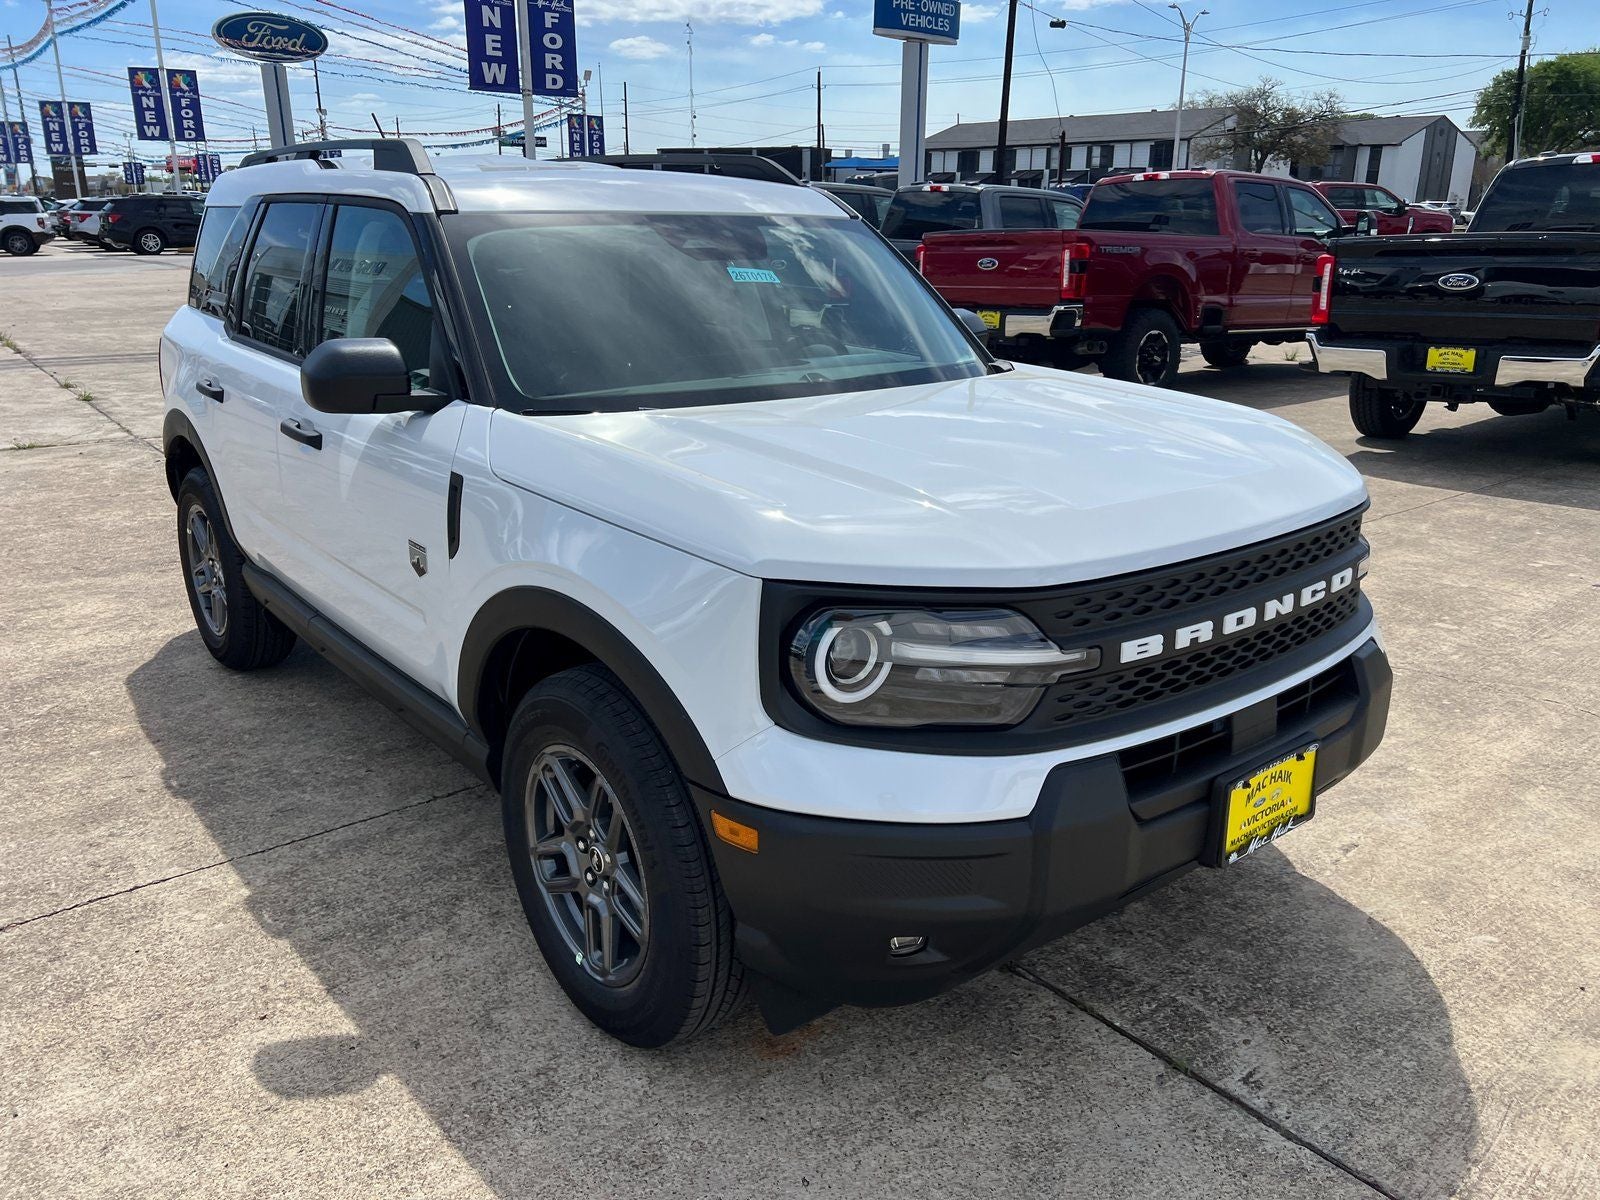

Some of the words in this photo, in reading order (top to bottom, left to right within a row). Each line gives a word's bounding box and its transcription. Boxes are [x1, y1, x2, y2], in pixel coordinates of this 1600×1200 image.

[242, 21, 306, 50] Ford
[901, 13, 950, 32] VEHICLES
[481, 5, 507, 85] NEW
[542, 12, 564, 90] FORD
[141, 96, 160, 137] NEW
[180, 98, 196, 139] FORD
[18, 137, 29, 162] FORD
[49, 122, 63, 152] NEW
[78, 123, 90, 153] FORD
[1099, 246, 1141, 255] TREMOR
[1446, 276, 1470, 287] Ford
[1120, 568, 1353, 664] BRONCO
[1245, 776, 1269, 807] MAC
[1269, 769, 1293, 785] HAIK
[1247, 799, 1286, 827] VICTORIA
